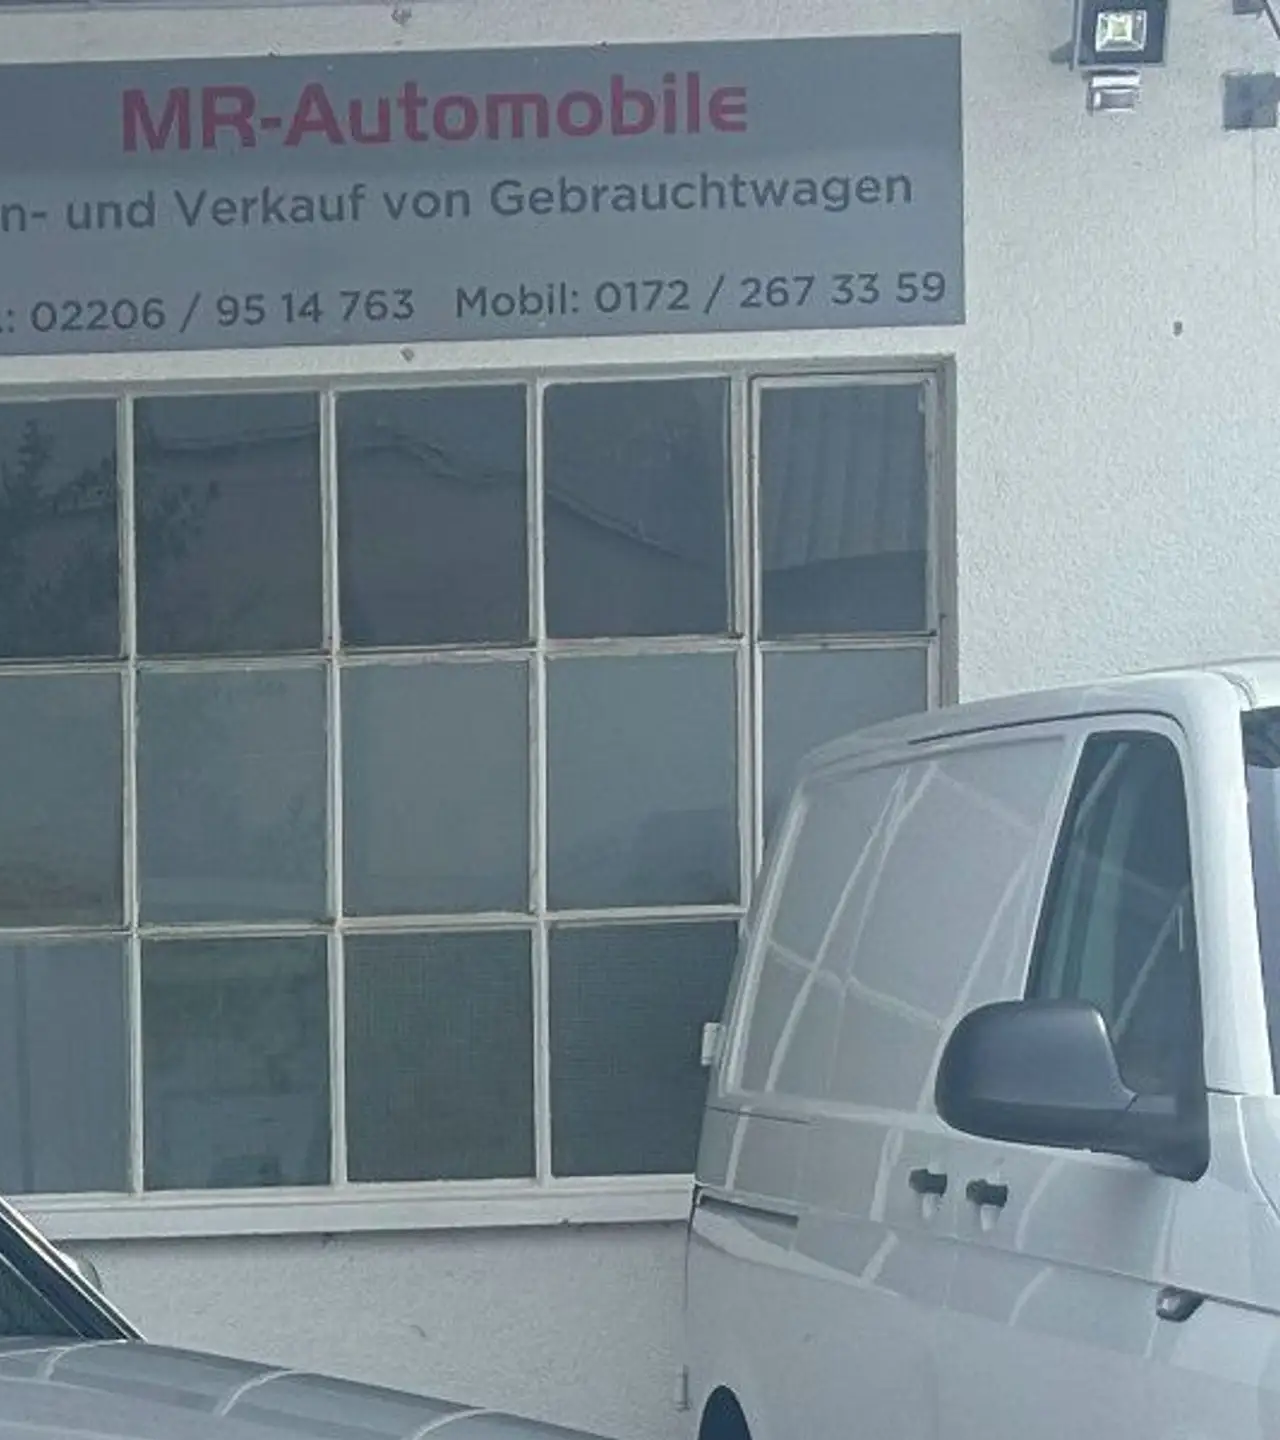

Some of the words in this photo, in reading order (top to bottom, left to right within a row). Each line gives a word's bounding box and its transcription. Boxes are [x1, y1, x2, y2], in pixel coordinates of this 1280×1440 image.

[122, 72, 748, 151] MR-Automobile
[67, 191, 155, 230] und
[174, 184, 366, 227] Verkauf
[384, 189, 470, 219] von
[490, 173, 913, 216] Gebrauchtwagen
[31, 297, 167, 333] 02206
[179, 291, 202, 333] /
[215, 292, 266, 328] 95
[283, 291, 324, 325] 14
[340, 287, 415, 323] 763
[455, 282, 578, 318] Mobil:
[594, 280, 690, 314] 0172
[702, 274, 726, 314] /
[740, 275, 815, 309] 267
[830, 272, 880, 305] 33
[896, 271, 947, 302] 59
